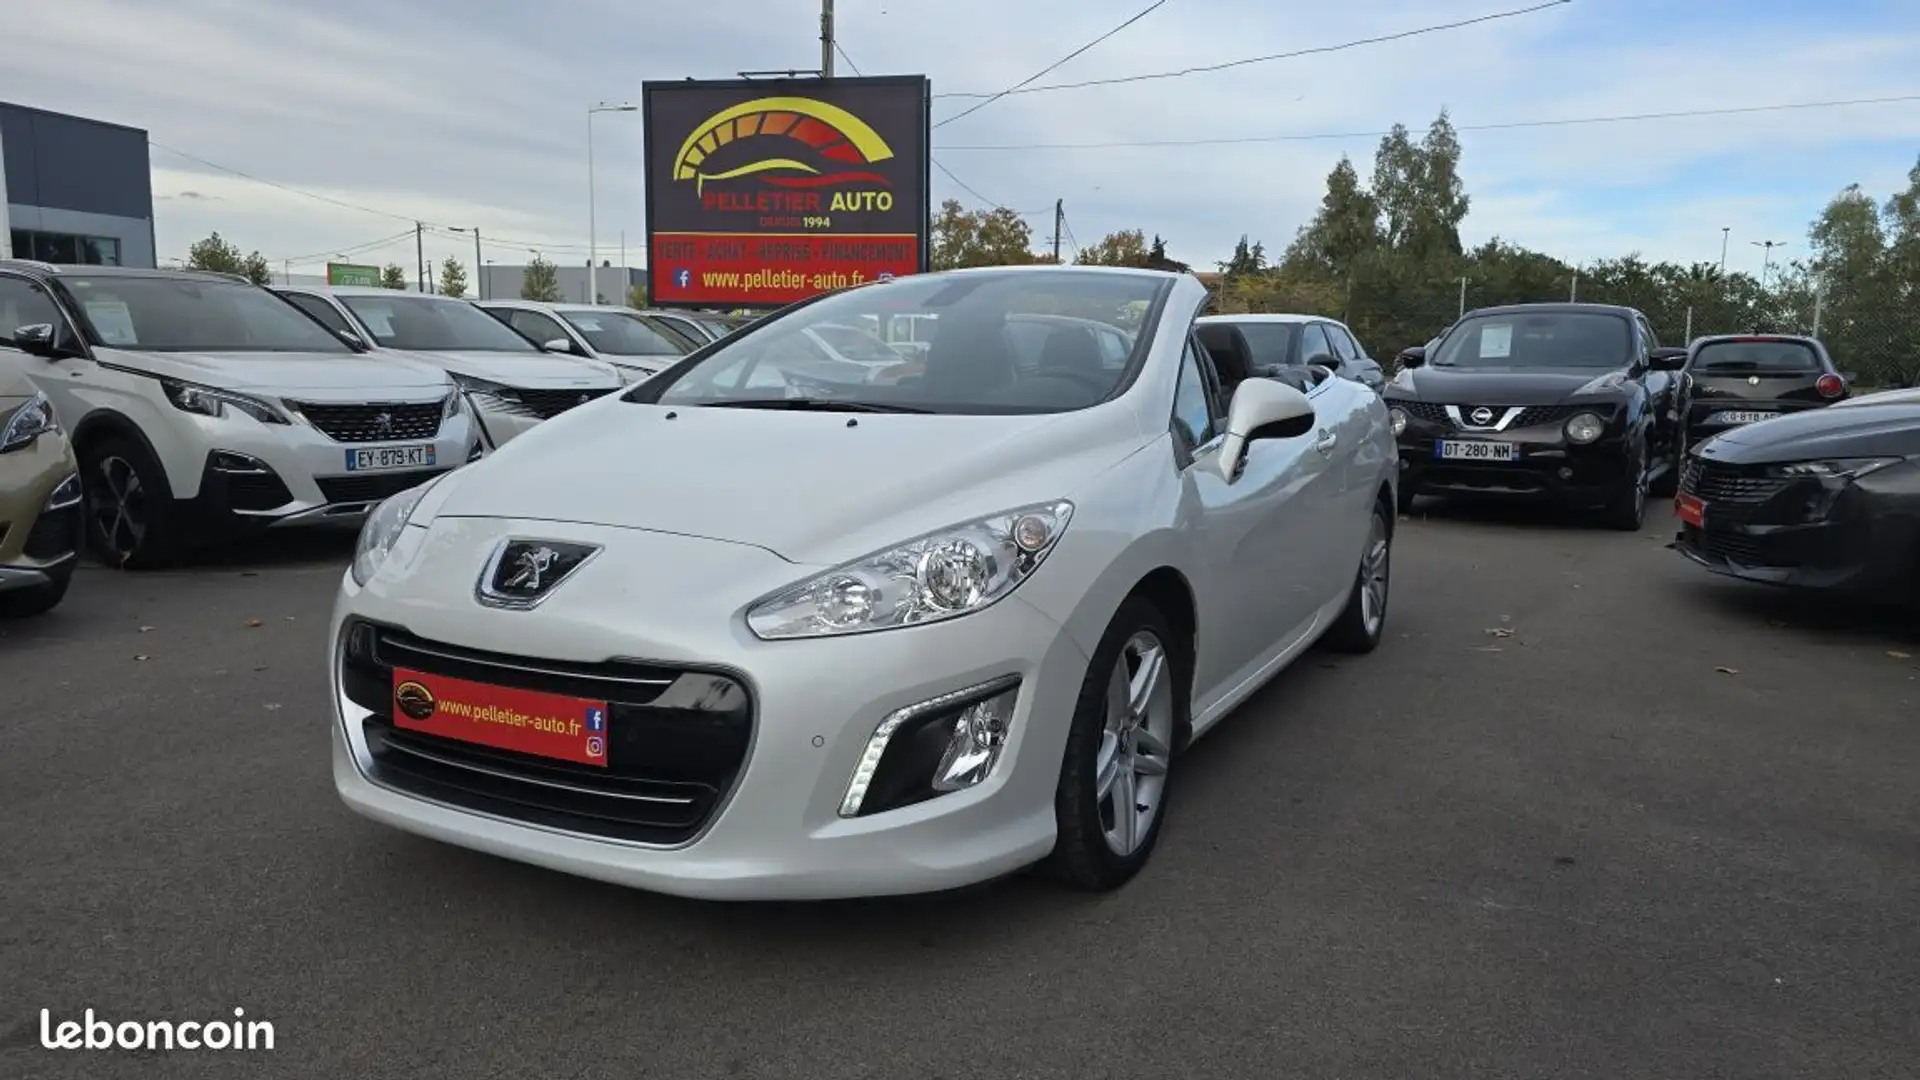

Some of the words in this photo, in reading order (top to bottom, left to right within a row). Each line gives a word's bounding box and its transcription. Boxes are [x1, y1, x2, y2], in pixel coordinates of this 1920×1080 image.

[704, 192, 821, 211] PELLETIER
[829, 191, 893, 212] AUTO
[803, 216, 831, 228] 1994
[758, 241, 811, 261] REPRISE
[822, 242, 910, 262] FINANCEMENT
[358, 448, 423, 467] EY-879-KT
[1444, 443, 1510, 458] DT-280-NM
[438, 699, 582, 736] www.pelletier-auto.fr
